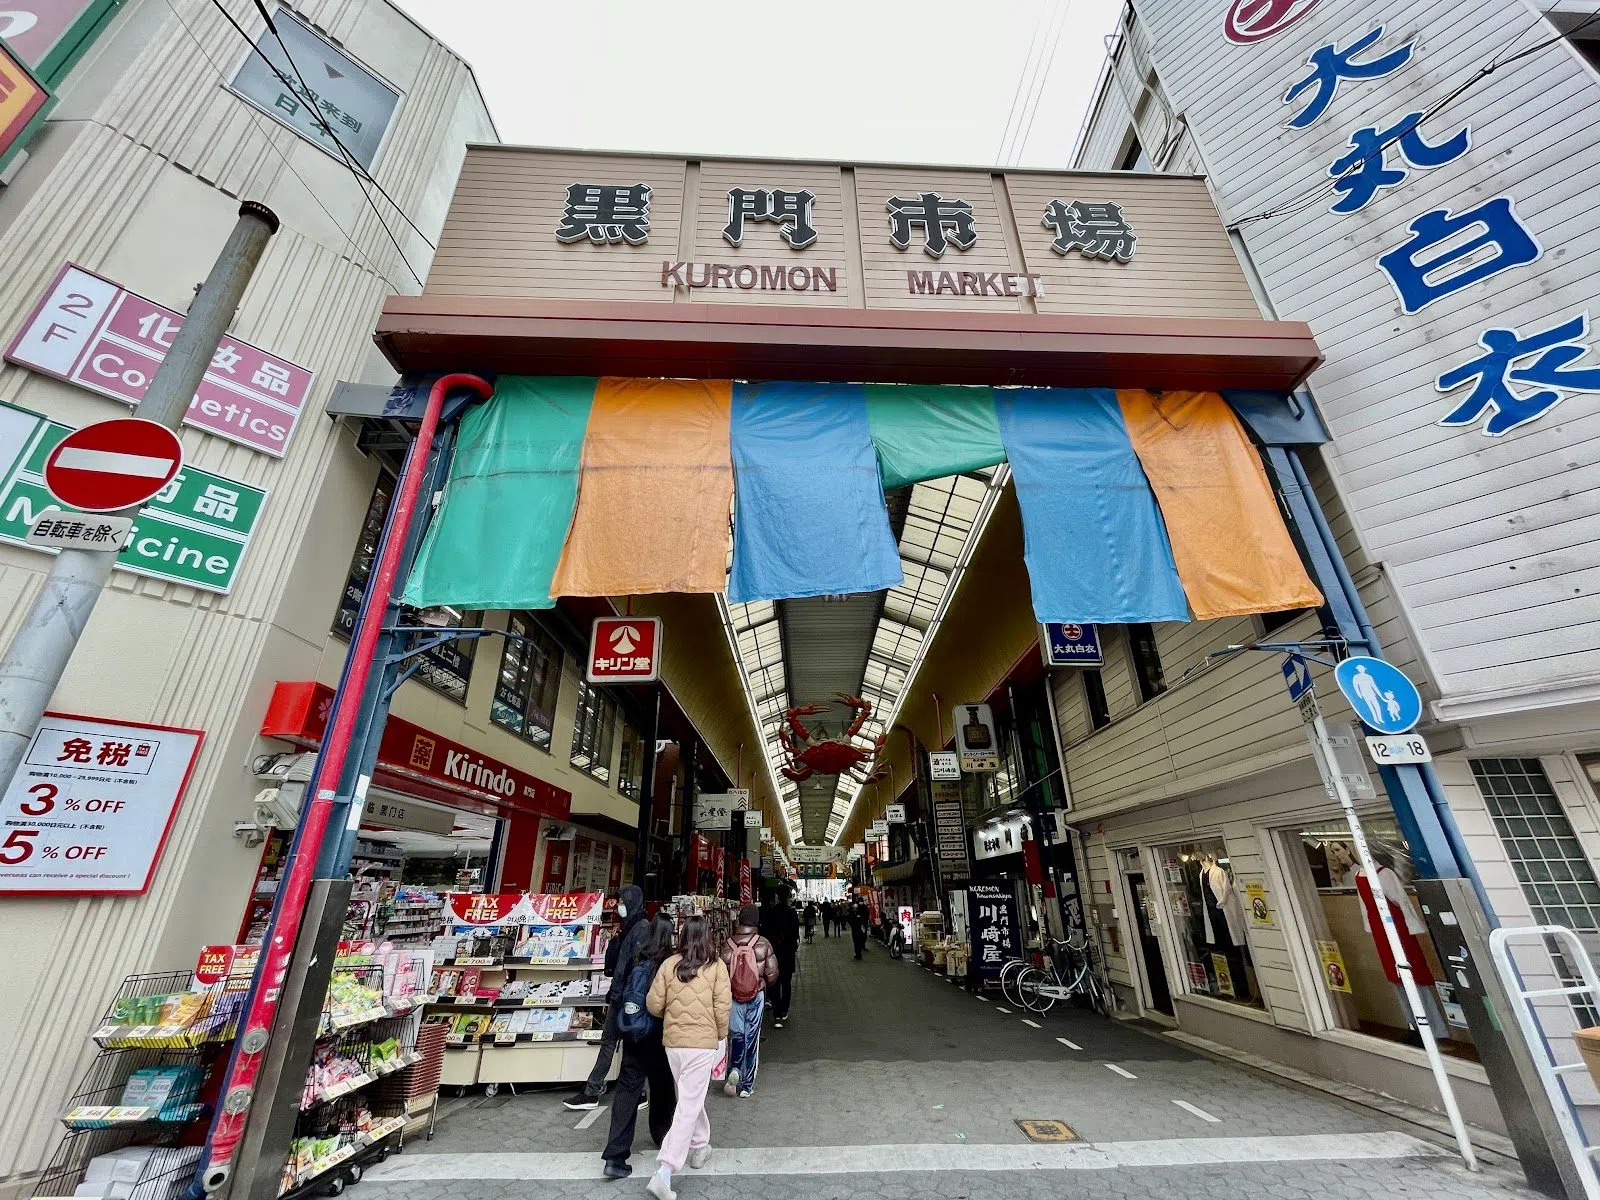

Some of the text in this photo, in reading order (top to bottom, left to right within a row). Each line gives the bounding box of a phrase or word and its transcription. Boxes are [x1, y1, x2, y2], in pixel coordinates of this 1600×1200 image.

[1282, 23, 1600, 437] 大丸白衣
[660, 260, 1044, 298] KUROMON MARKET
[6, 496, 230, 575] Micine
[33, 519, 123, 543] 自転車を除く
[1053, 643, 1097, 655] 大丸白衣
[594, 656, 650, 672] キリン堂
[56, 737, 133, 767] 免税
[1372, 740, 1425, 757] 12 18
[443, 749, 516, 797] Kirindo
[20, 783, 126, 816] 3 % OFF
[0, 829, 108, 865] 5 % OFF
[470, 896, 500, 908] TAX
[551, 896, 578, 908] TAX
[464, 908, 499, 921] FREE
[545, 908, 578, 920] FREE
[900, 909, 912, 923] 肉
[204, 953, 226, 963] TAX
[199, 964, 225, 974] FREE
